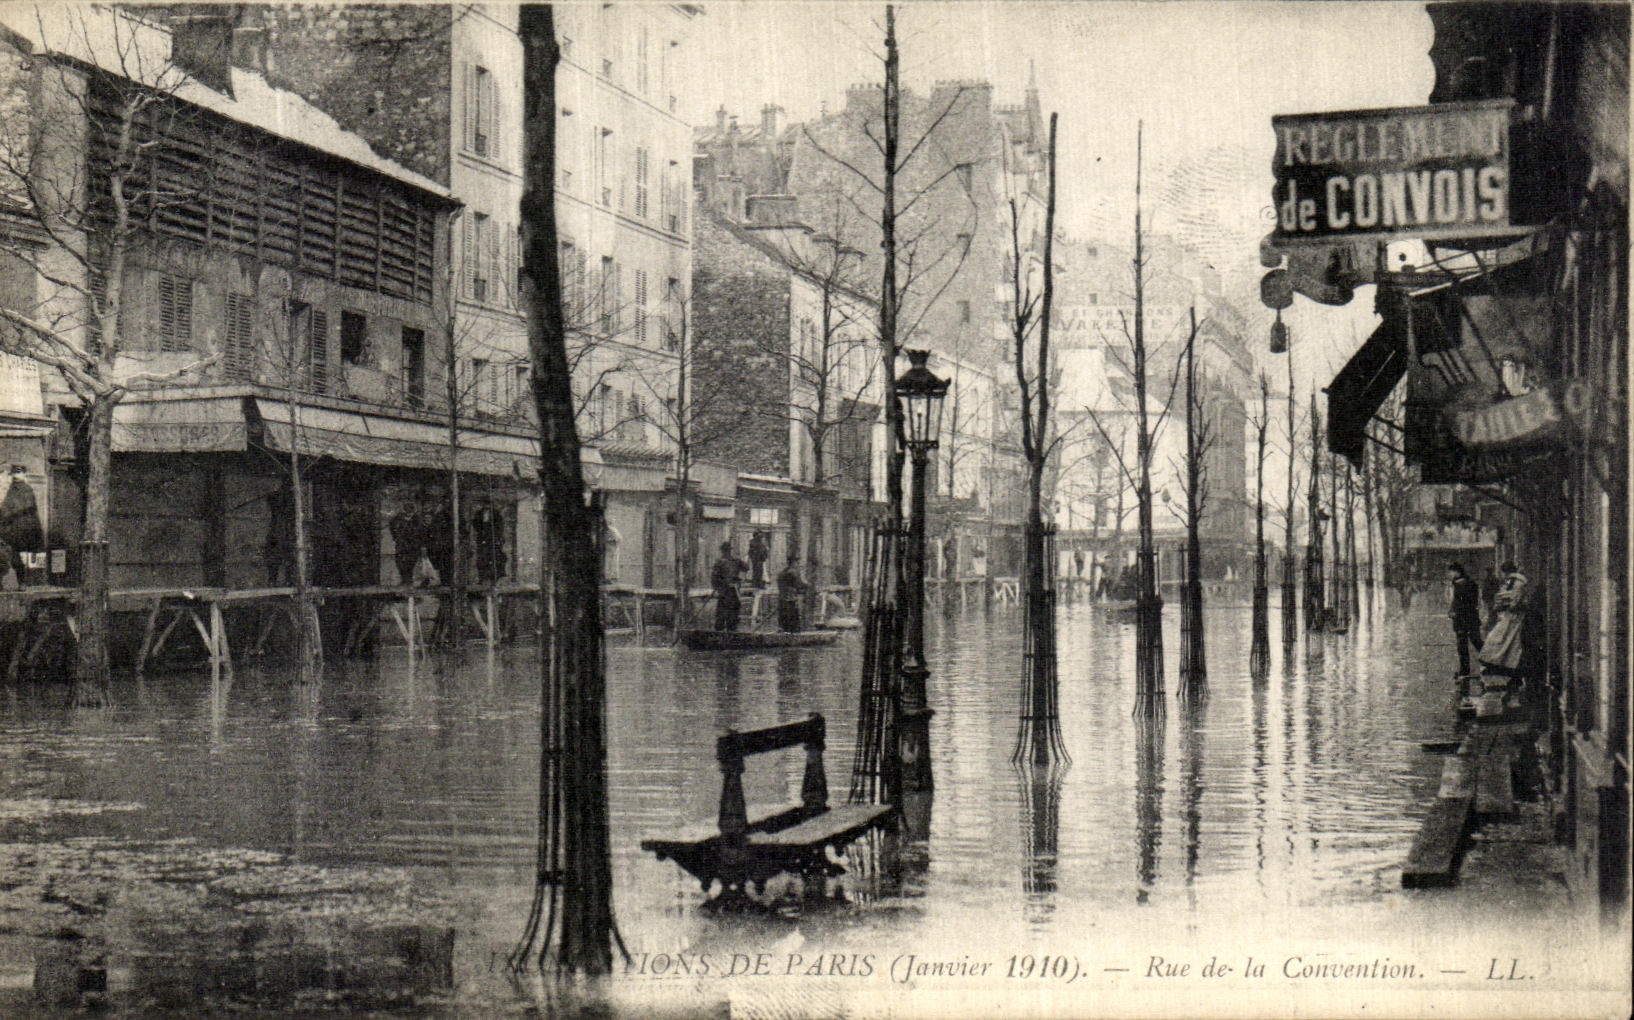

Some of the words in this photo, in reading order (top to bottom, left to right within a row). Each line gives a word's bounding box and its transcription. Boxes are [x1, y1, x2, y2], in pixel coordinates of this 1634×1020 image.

[1283, 111, 1503, 166] REGLEMENT
[1281, 179, 1317, 231] de
[1326, 166, 1504, 229] CONVOIS
